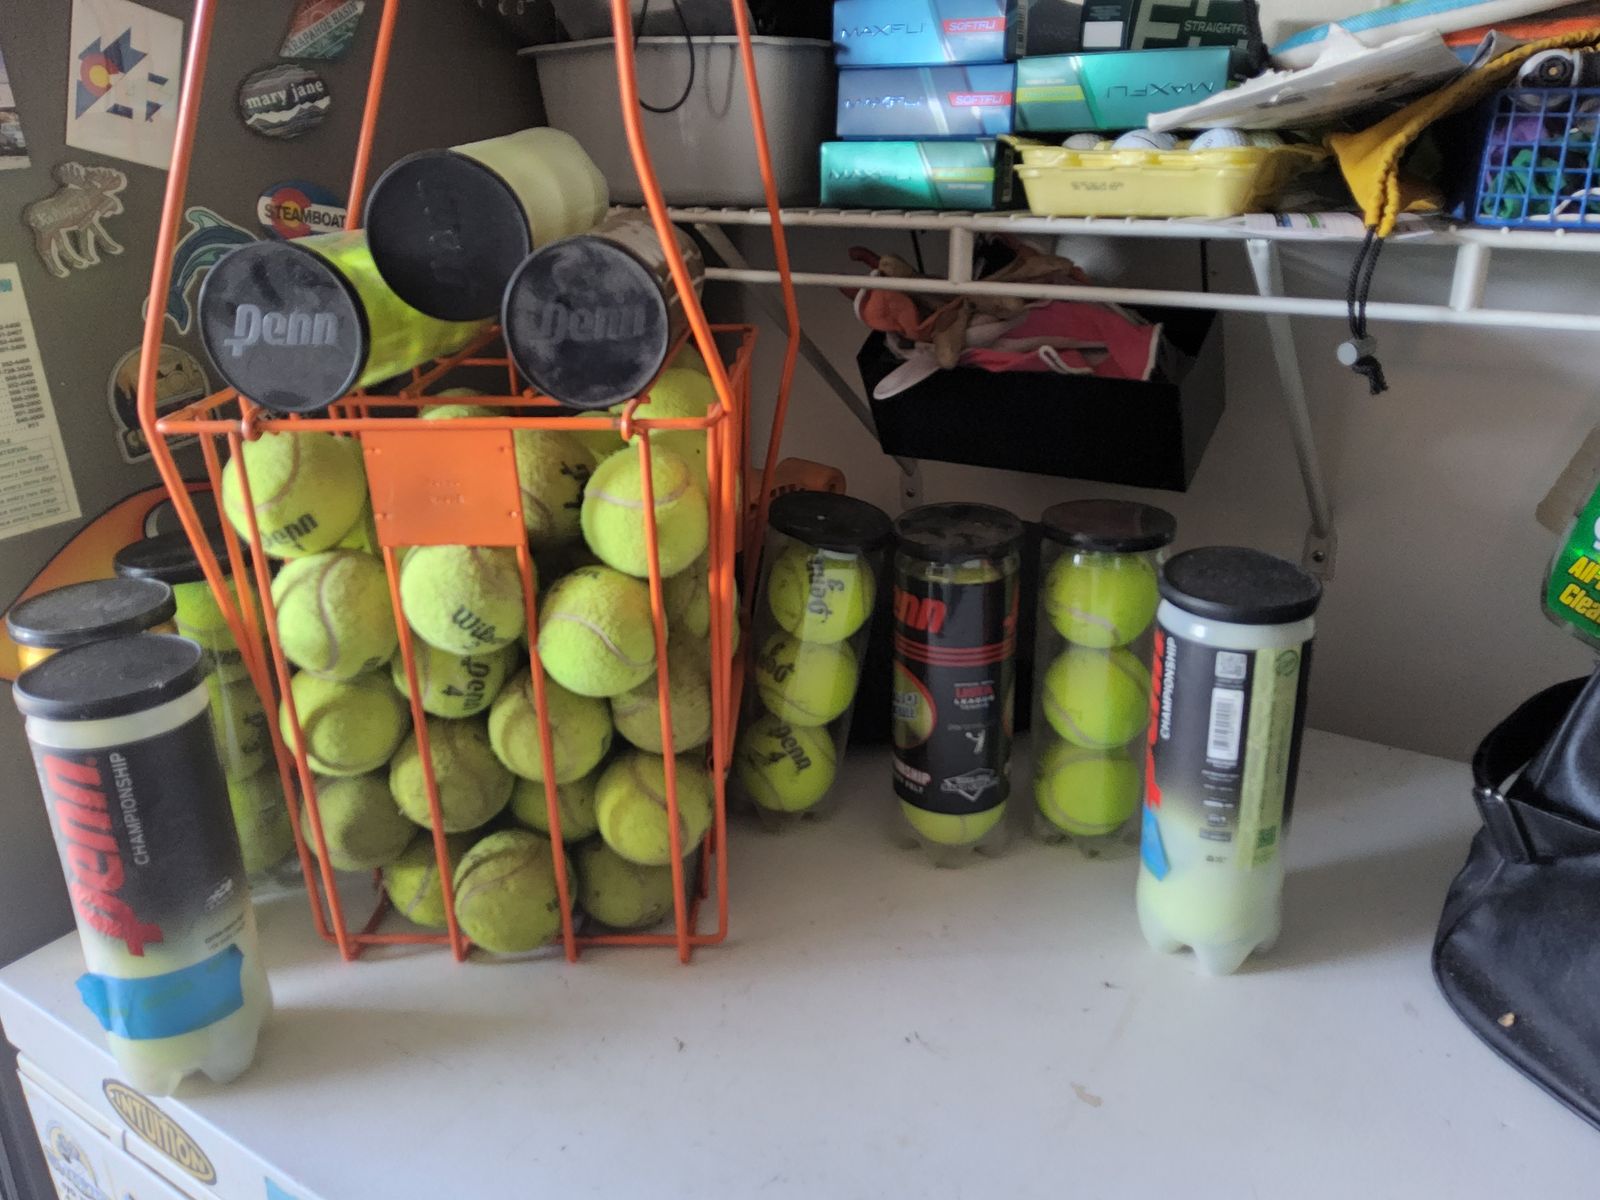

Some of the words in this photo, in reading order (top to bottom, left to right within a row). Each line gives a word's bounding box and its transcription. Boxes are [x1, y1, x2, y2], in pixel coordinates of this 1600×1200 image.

[841, 23, 924, 39] MAXFLI
[1184, 19, 1249, 35] STRAIGHTFL
[246, 89, 288, 109] mary
[290, 80, 324, 102] jane
[1106, 80, 1215, 98] MAXFLI
[264, 203, 347, 228] STEAMBOAT
[224, 304, 340, 357] Penn
[1558, 582, 1600, 625] Clea
[1159, 636, 1177, 740] CHAMPIONSHIP
[109, 751, 150, 866] CHAMPIONSHIP
[42, 752, 164, 957] Penn
